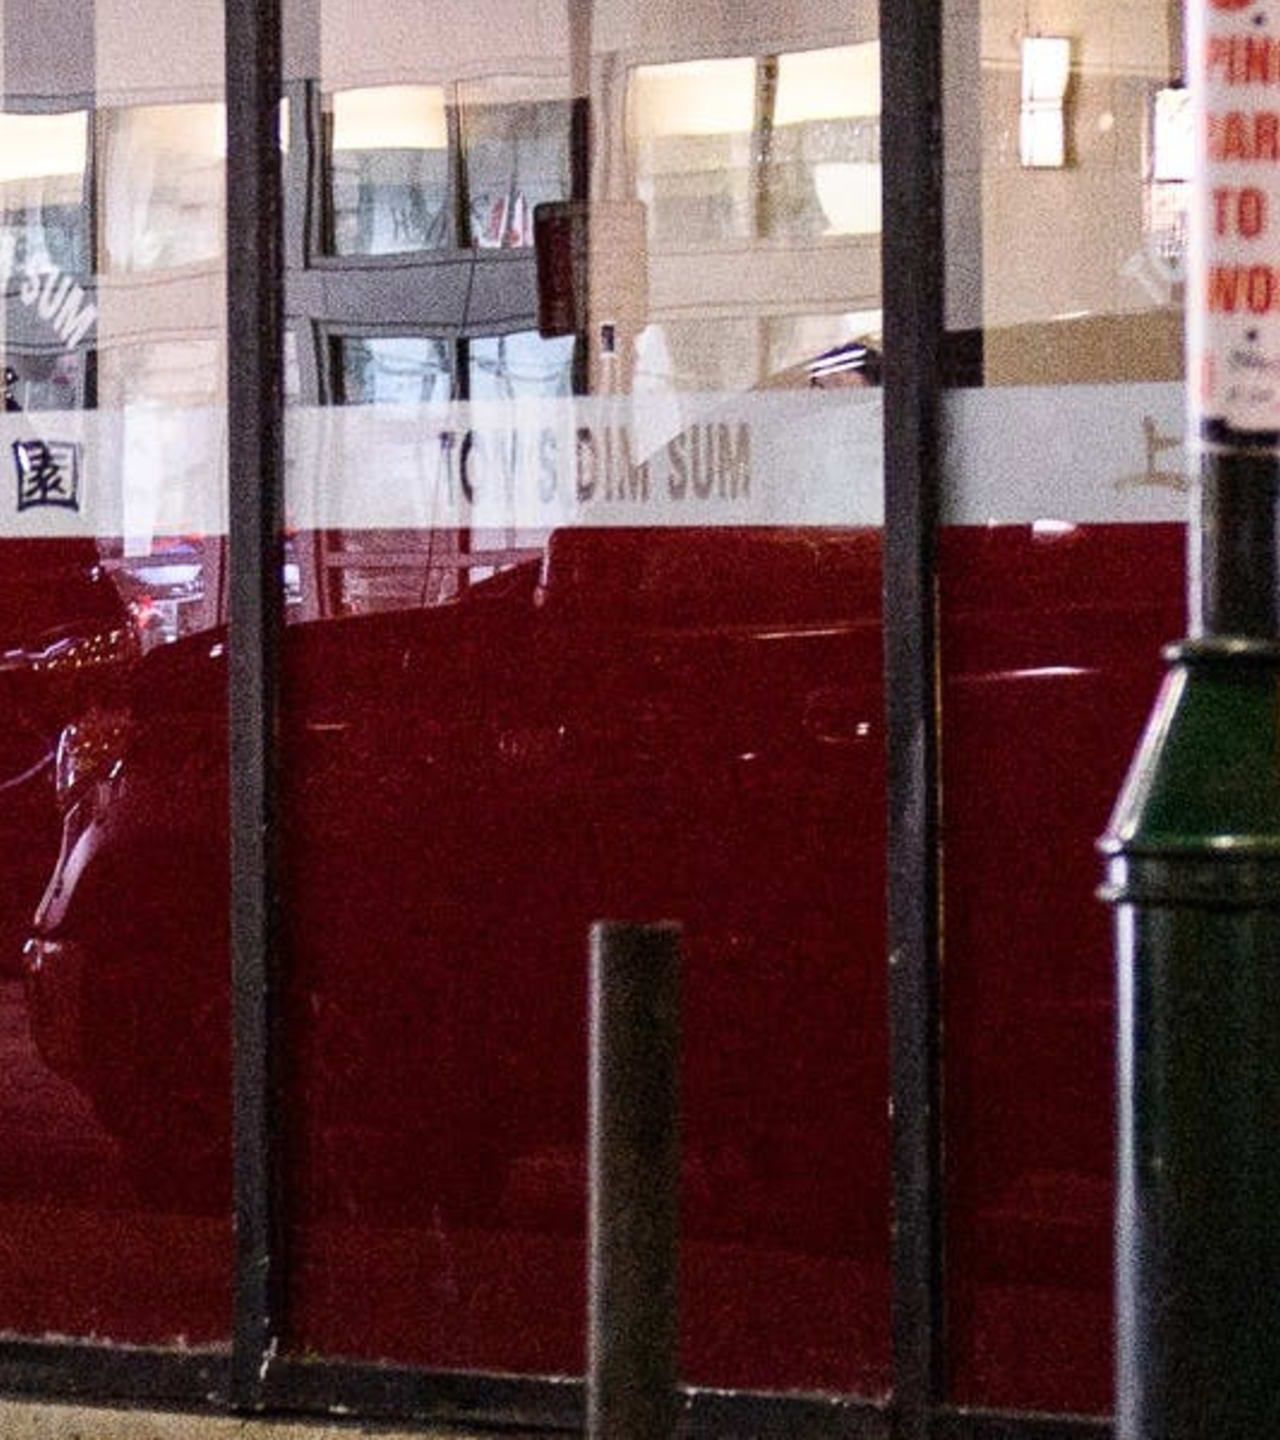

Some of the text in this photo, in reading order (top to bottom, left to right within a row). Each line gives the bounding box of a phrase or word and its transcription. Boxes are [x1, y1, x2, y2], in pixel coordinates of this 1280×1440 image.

[1213, 186, 1265, 238] TO
[22, 251, 98, 350] SUM
[577, 426, 650, 503] DIM
[669, 422, 750, 501] SUM
